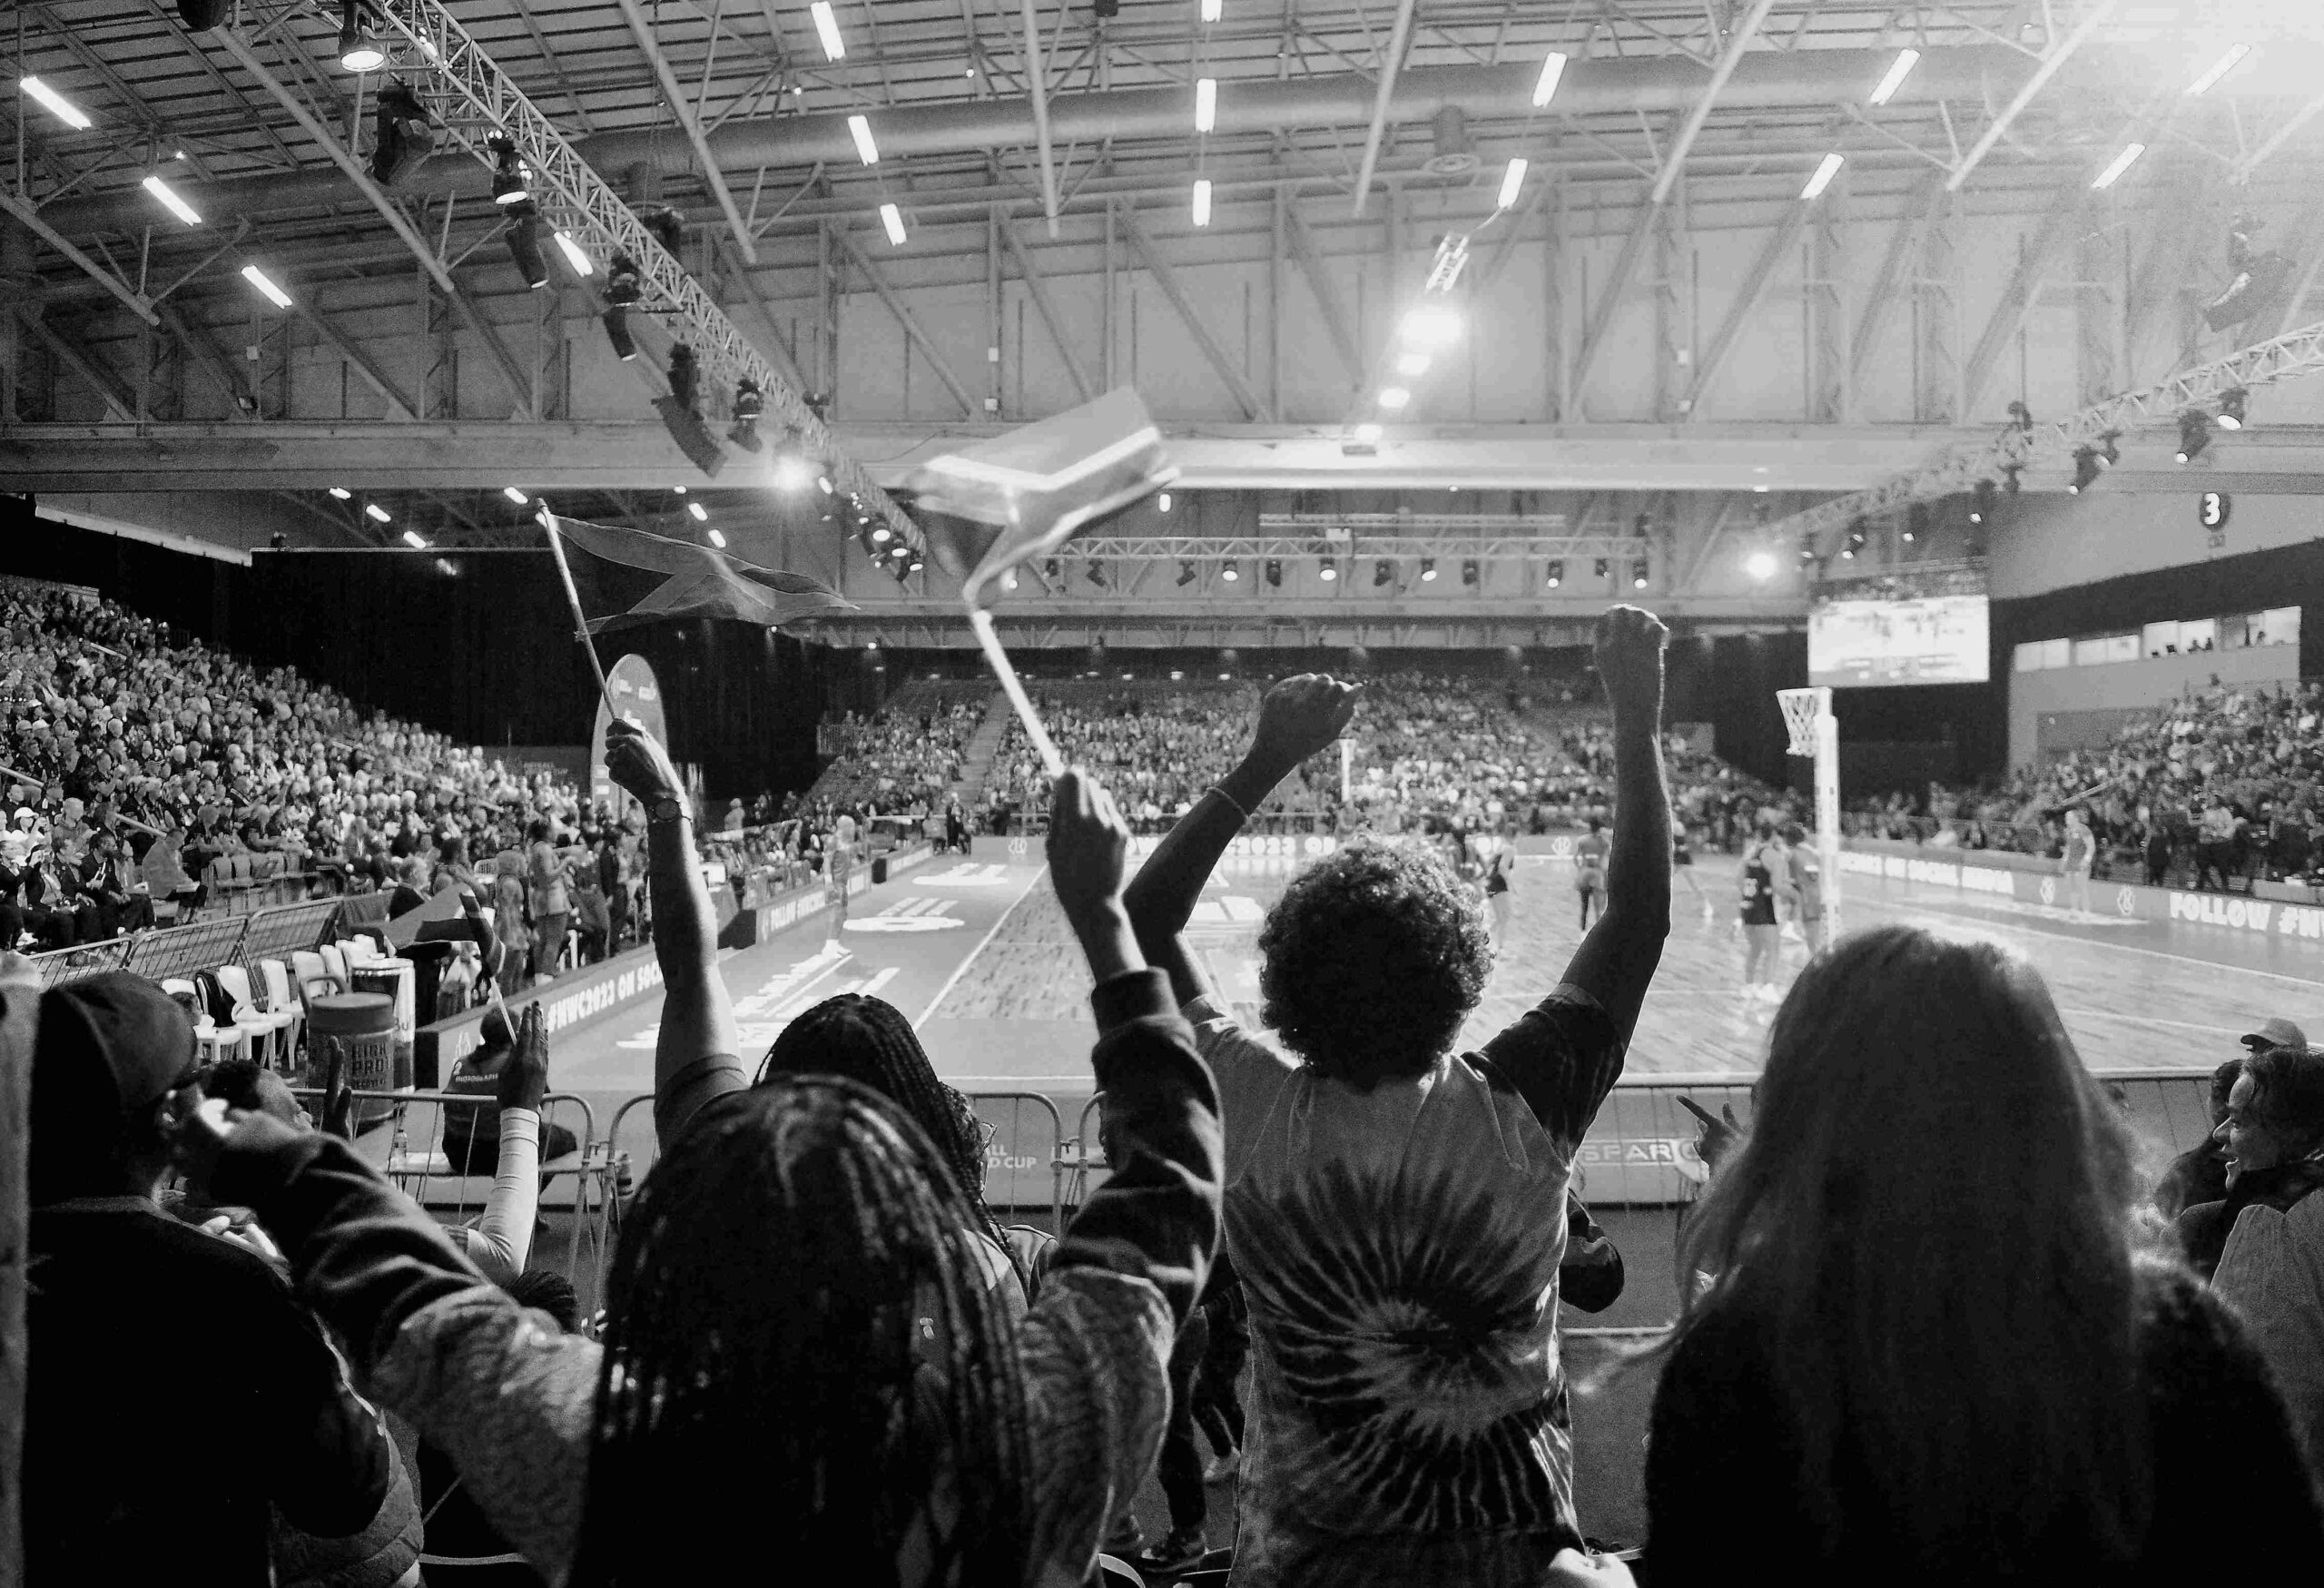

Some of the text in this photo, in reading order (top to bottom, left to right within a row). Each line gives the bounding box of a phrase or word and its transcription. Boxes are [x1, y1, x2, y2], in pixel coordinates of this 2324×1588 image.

[2204, 493, 2221, 525] 3
[2170, 892, 2271, 931] FOLLOW
[547, 979, 615, 1034] #NWC2023
[617, 971, 635, 1001] ON
[1004, 1157, 1038, 1169] CUP
[1584, 1143, 1672, 1161] SPAR
